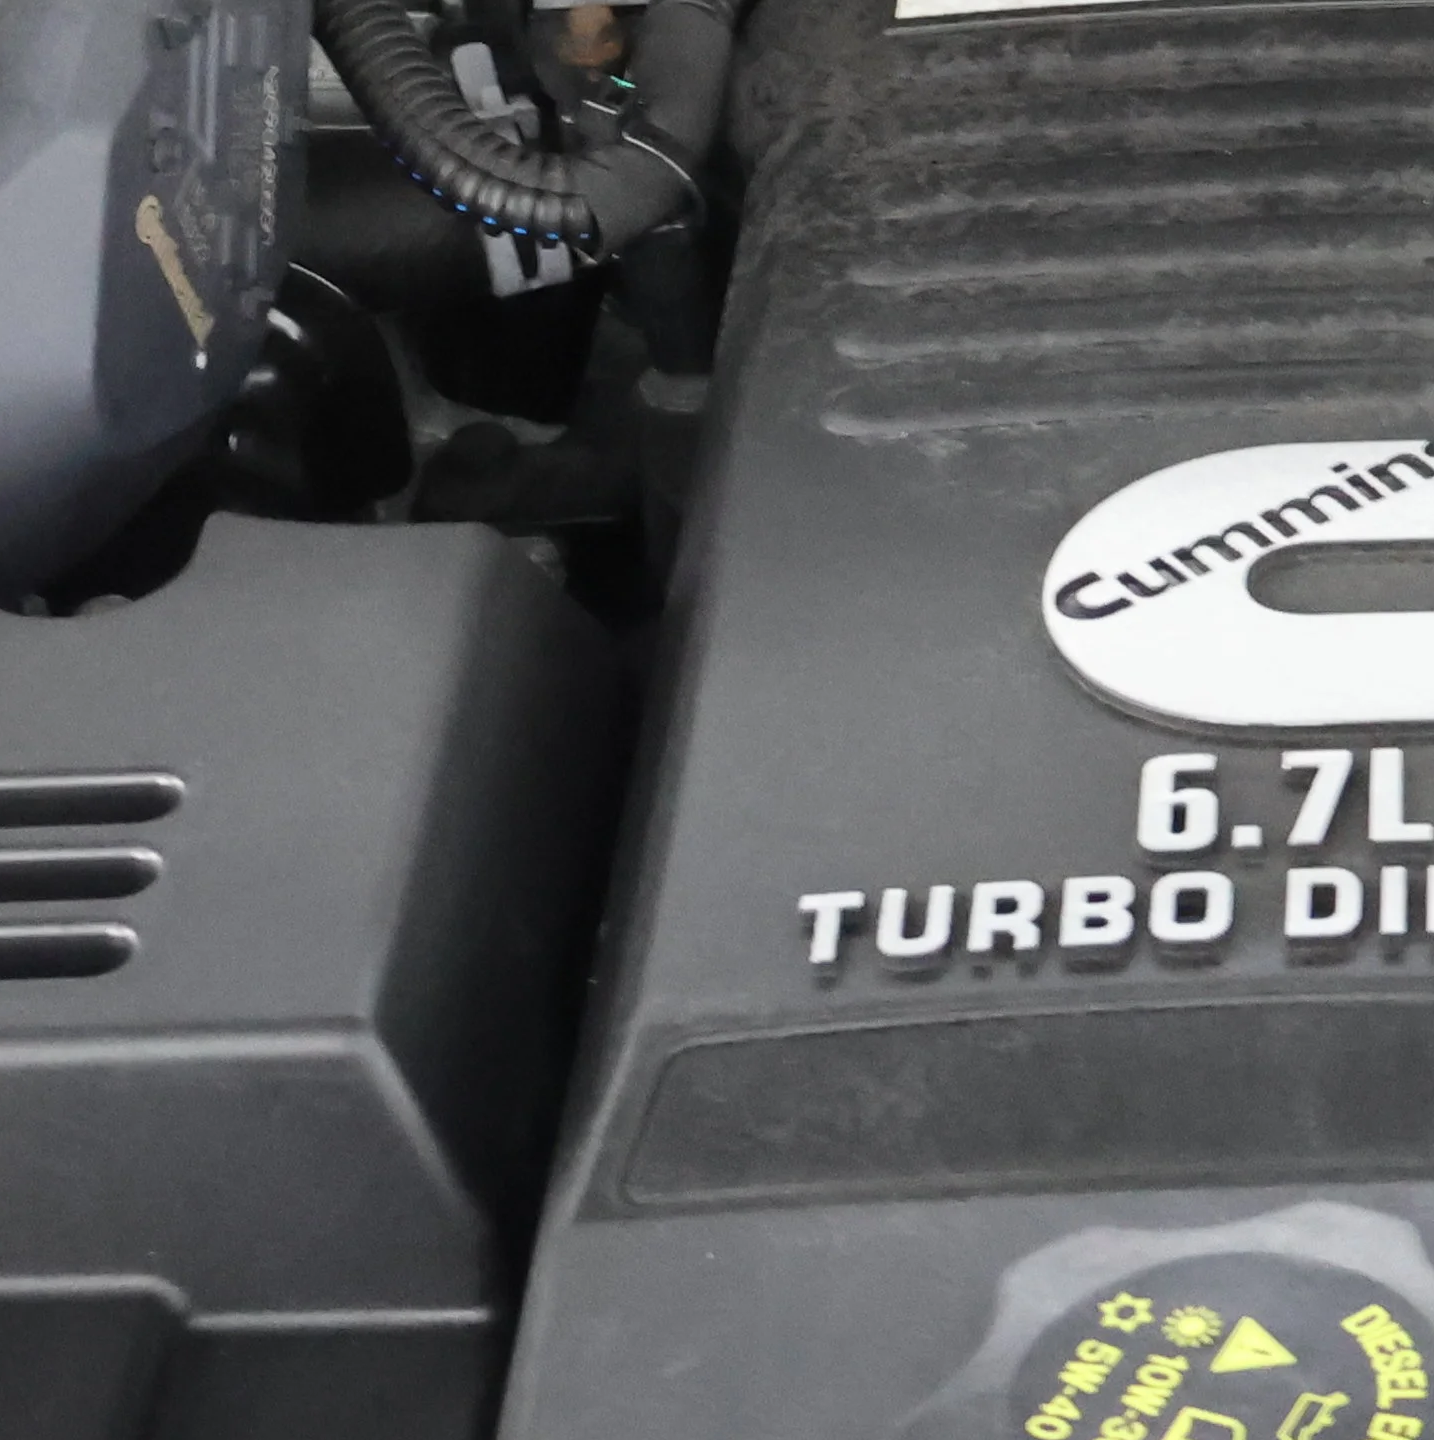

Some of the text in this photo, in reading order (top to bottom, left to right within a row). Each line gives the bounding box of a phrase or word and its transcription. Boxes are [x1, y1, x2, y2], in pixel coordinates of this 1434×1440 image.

[1137, 746, 1434, 853] 6.7L
[797, 869, 1234, 964] TURBO
[1339, 1303, 1429, 1410] DIESEL
